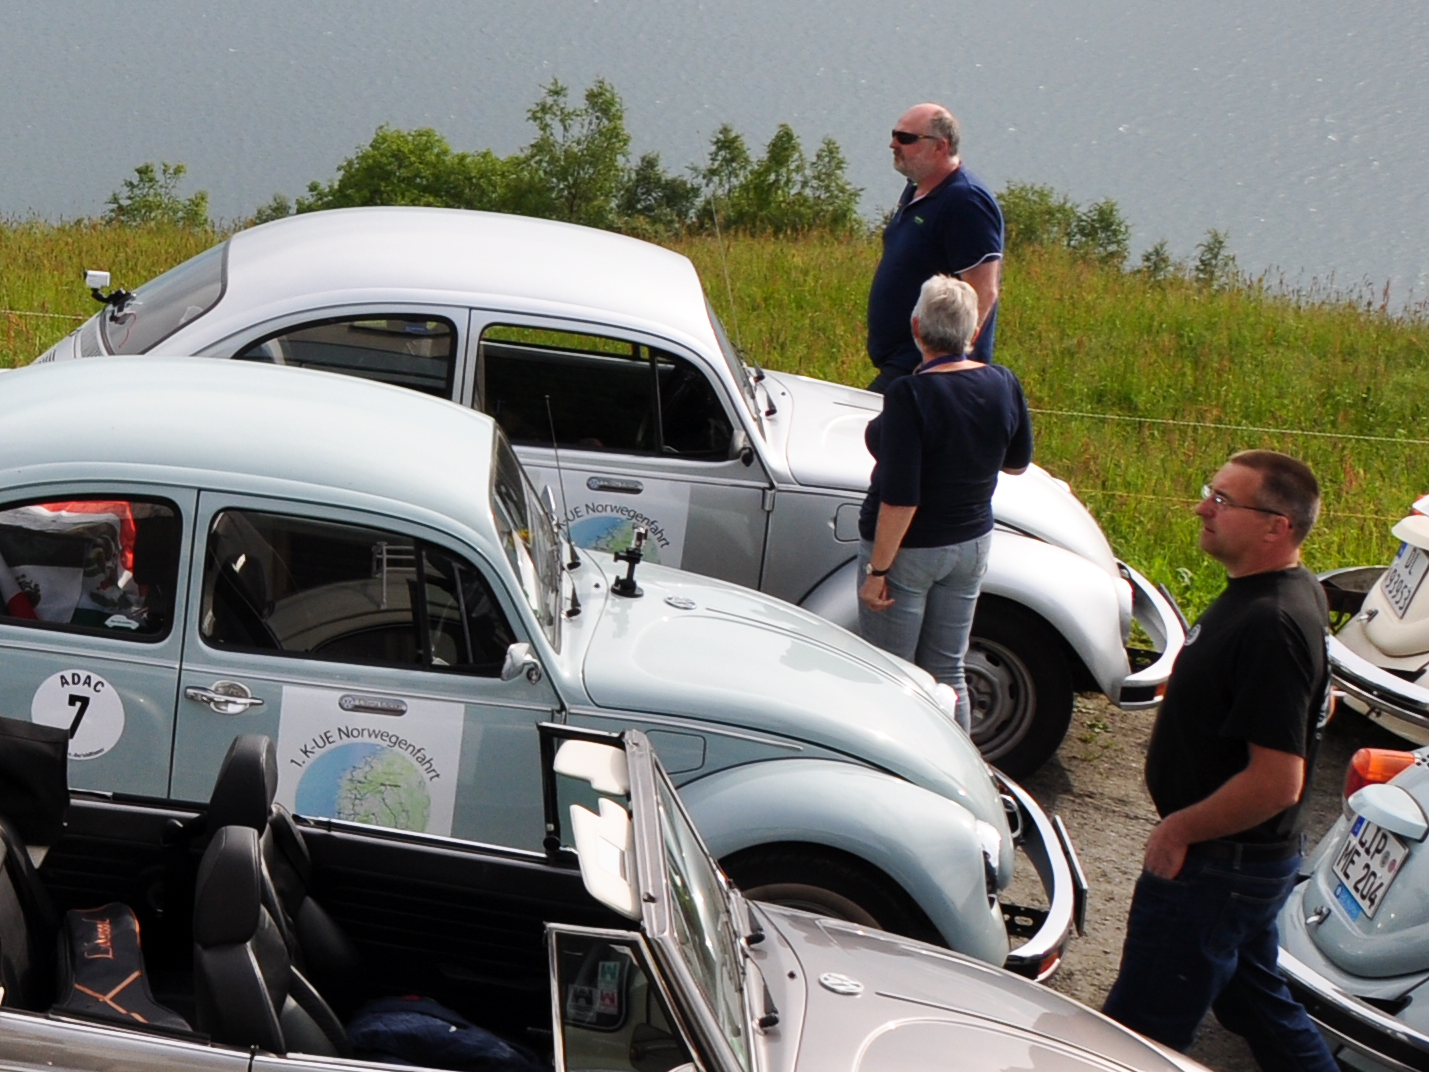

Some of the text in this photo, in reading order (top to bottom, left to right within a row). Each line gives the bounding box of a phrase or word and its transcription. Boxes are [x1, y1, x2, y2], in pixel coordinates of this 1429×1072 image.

[584, 502, 671, 549] Norwegenfahrt
[59, 672, 105, 694] ADAC
[67, 693, 91, 740] 7
[290, 724, 441, 782] 1. K-UE Norwegenfahrt
[1336, 839, 1362, 881] ME
[1357, 820, 1388, 861] LIP
[1352, 862, 1385, 910] 204
